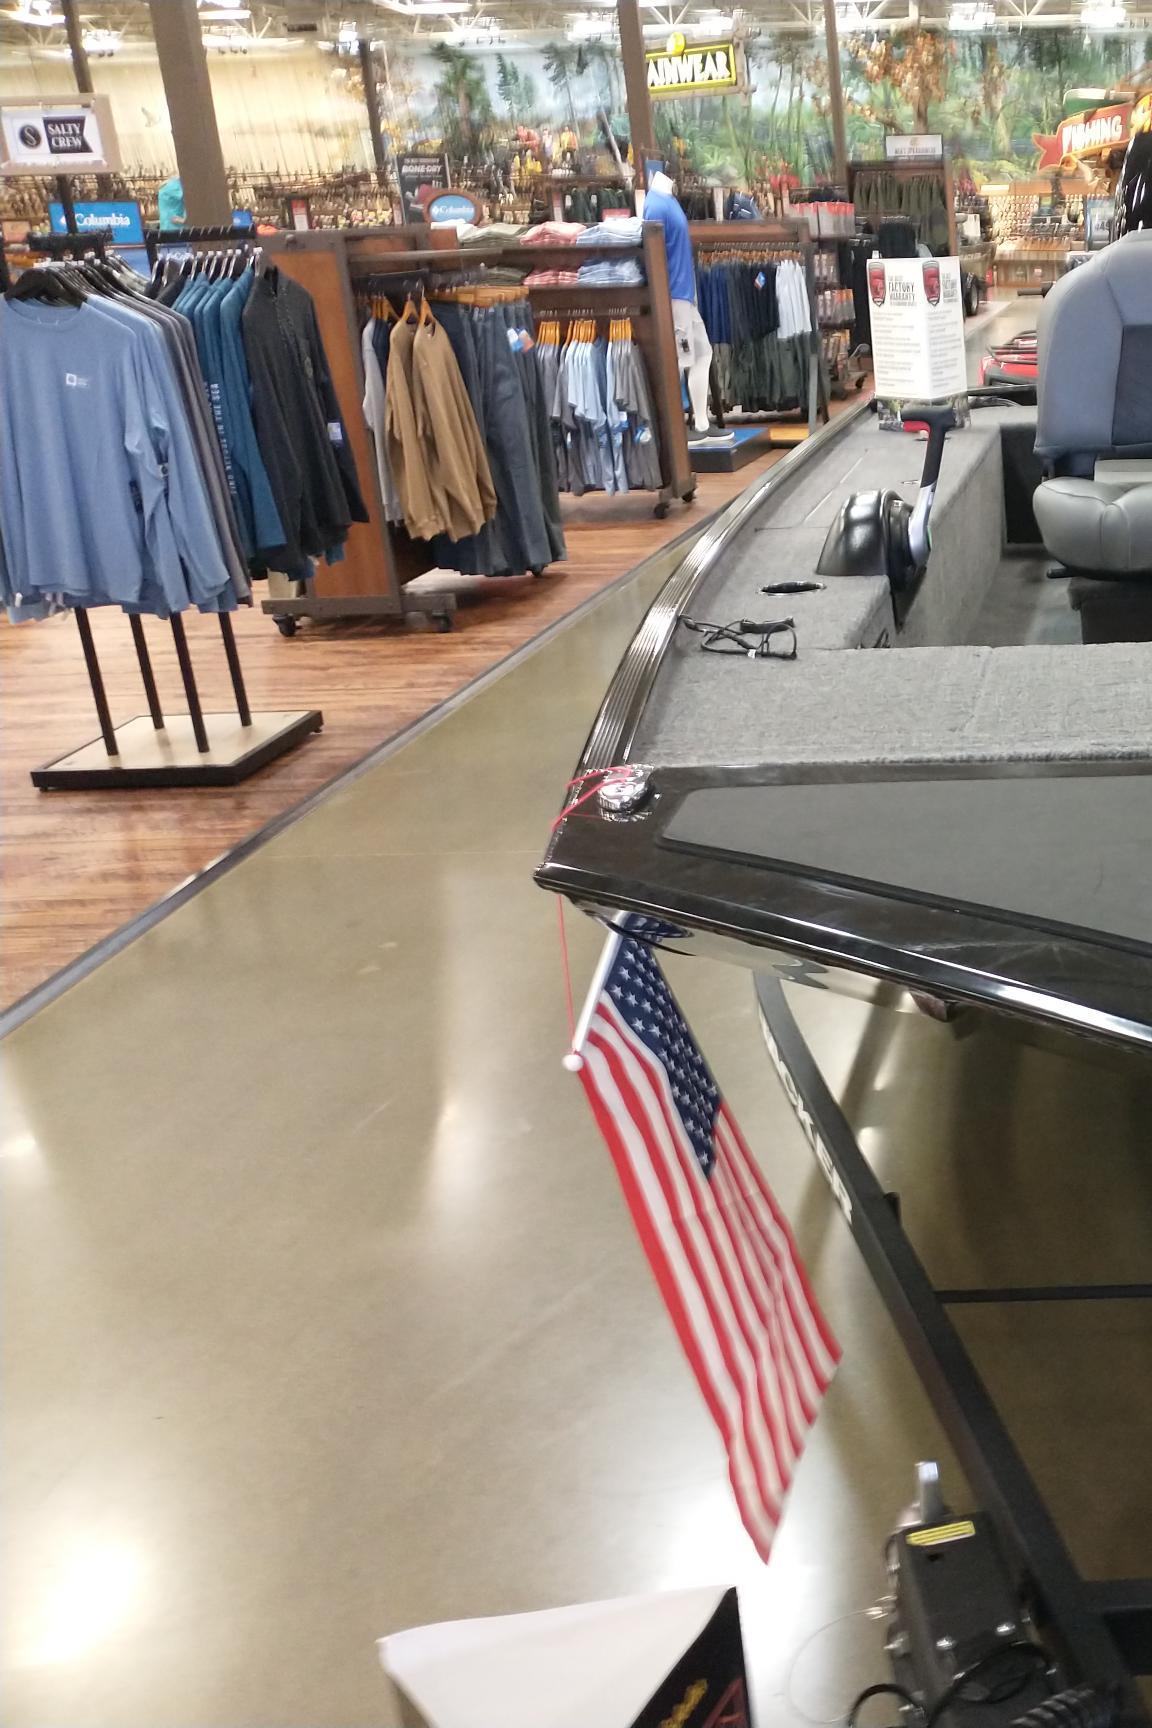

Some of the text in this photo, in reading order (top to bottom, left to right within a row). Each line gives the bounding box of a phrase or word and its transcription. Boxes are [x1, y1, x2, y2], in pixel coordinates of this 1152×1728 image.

[647, 51, 731, 87] AINWEAR
[48, 123, 81, 137] SALTY
[51, 136, 82, 148] CREW
[75, 212, 131, 227] Columbia
[888, 281, 915, 293] FACTORY
